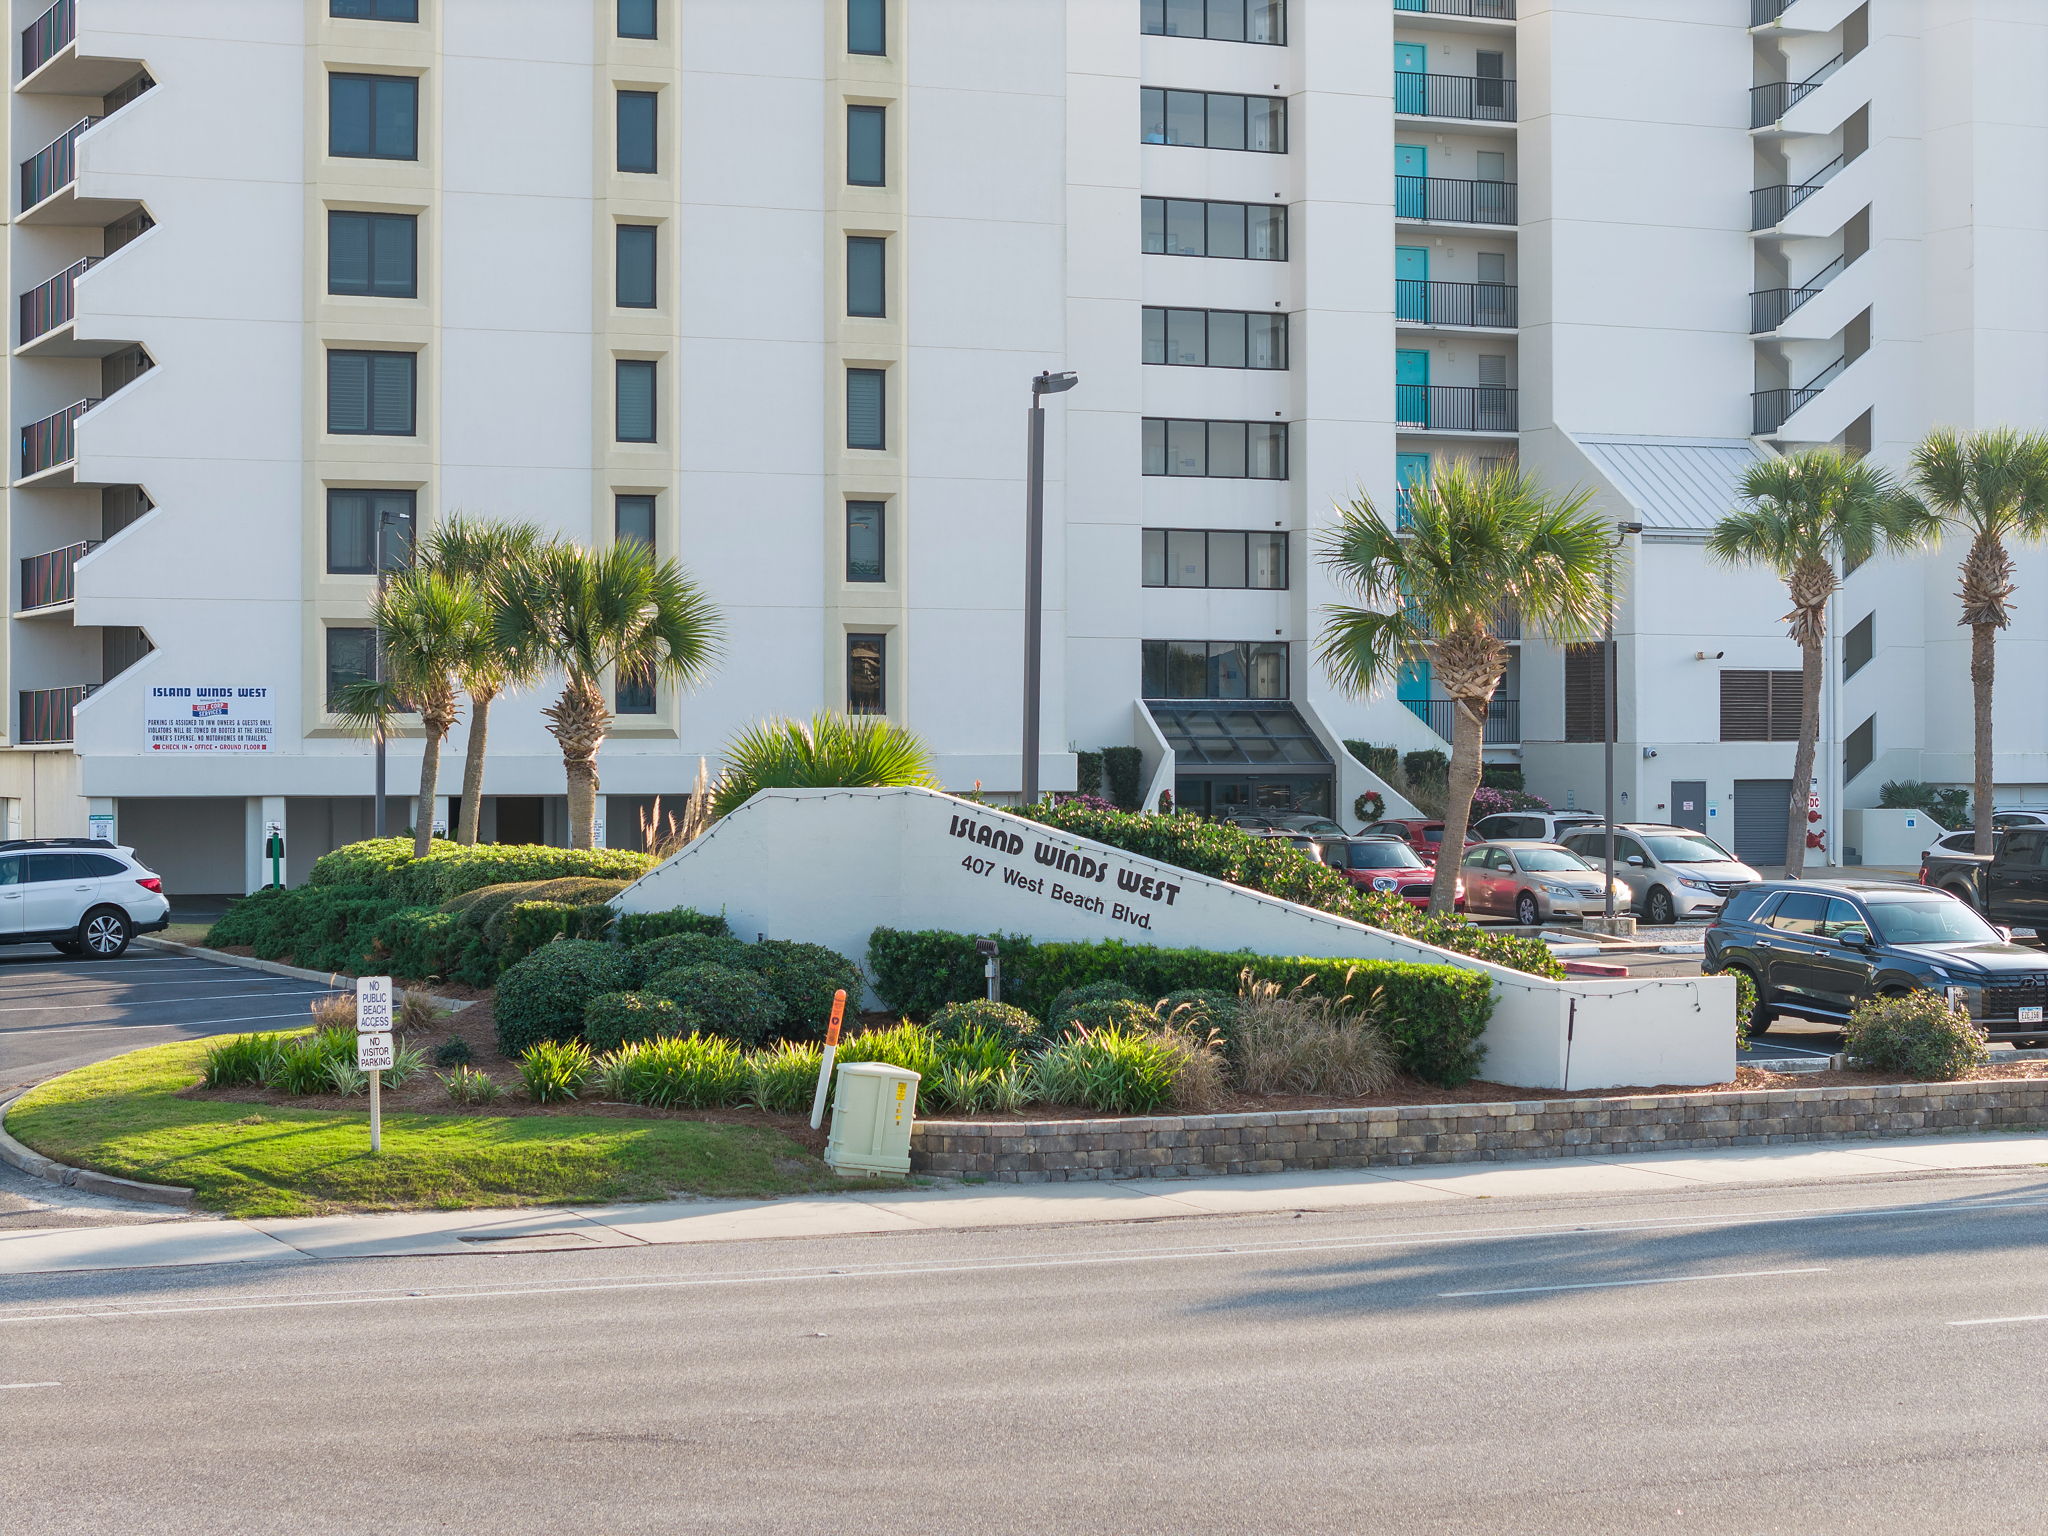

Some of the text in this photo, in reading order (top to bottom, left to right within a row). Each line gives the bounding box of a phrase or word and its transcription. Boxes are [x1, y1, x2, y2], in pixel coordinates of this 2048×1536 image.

[153, 687, 267, 697] ISLAND WINDS WEST
[949, 815, 1181, 906] ISLAND WINDS WEST
[961, 855, 1152, 930] 407 West Beach Blvd.
[369, 980, 380, 991] NO
[362, 993, 387, 1003] PUBLIC
[363, 1005, 387, 1015] BEACH
[361, 1016, 389, 1027] ACCESS
[369, 1037, 380, 1046] NO
[362, 1047, 389, 1056] VISITOR
[361, 1057, 391, 1067] PARKING
